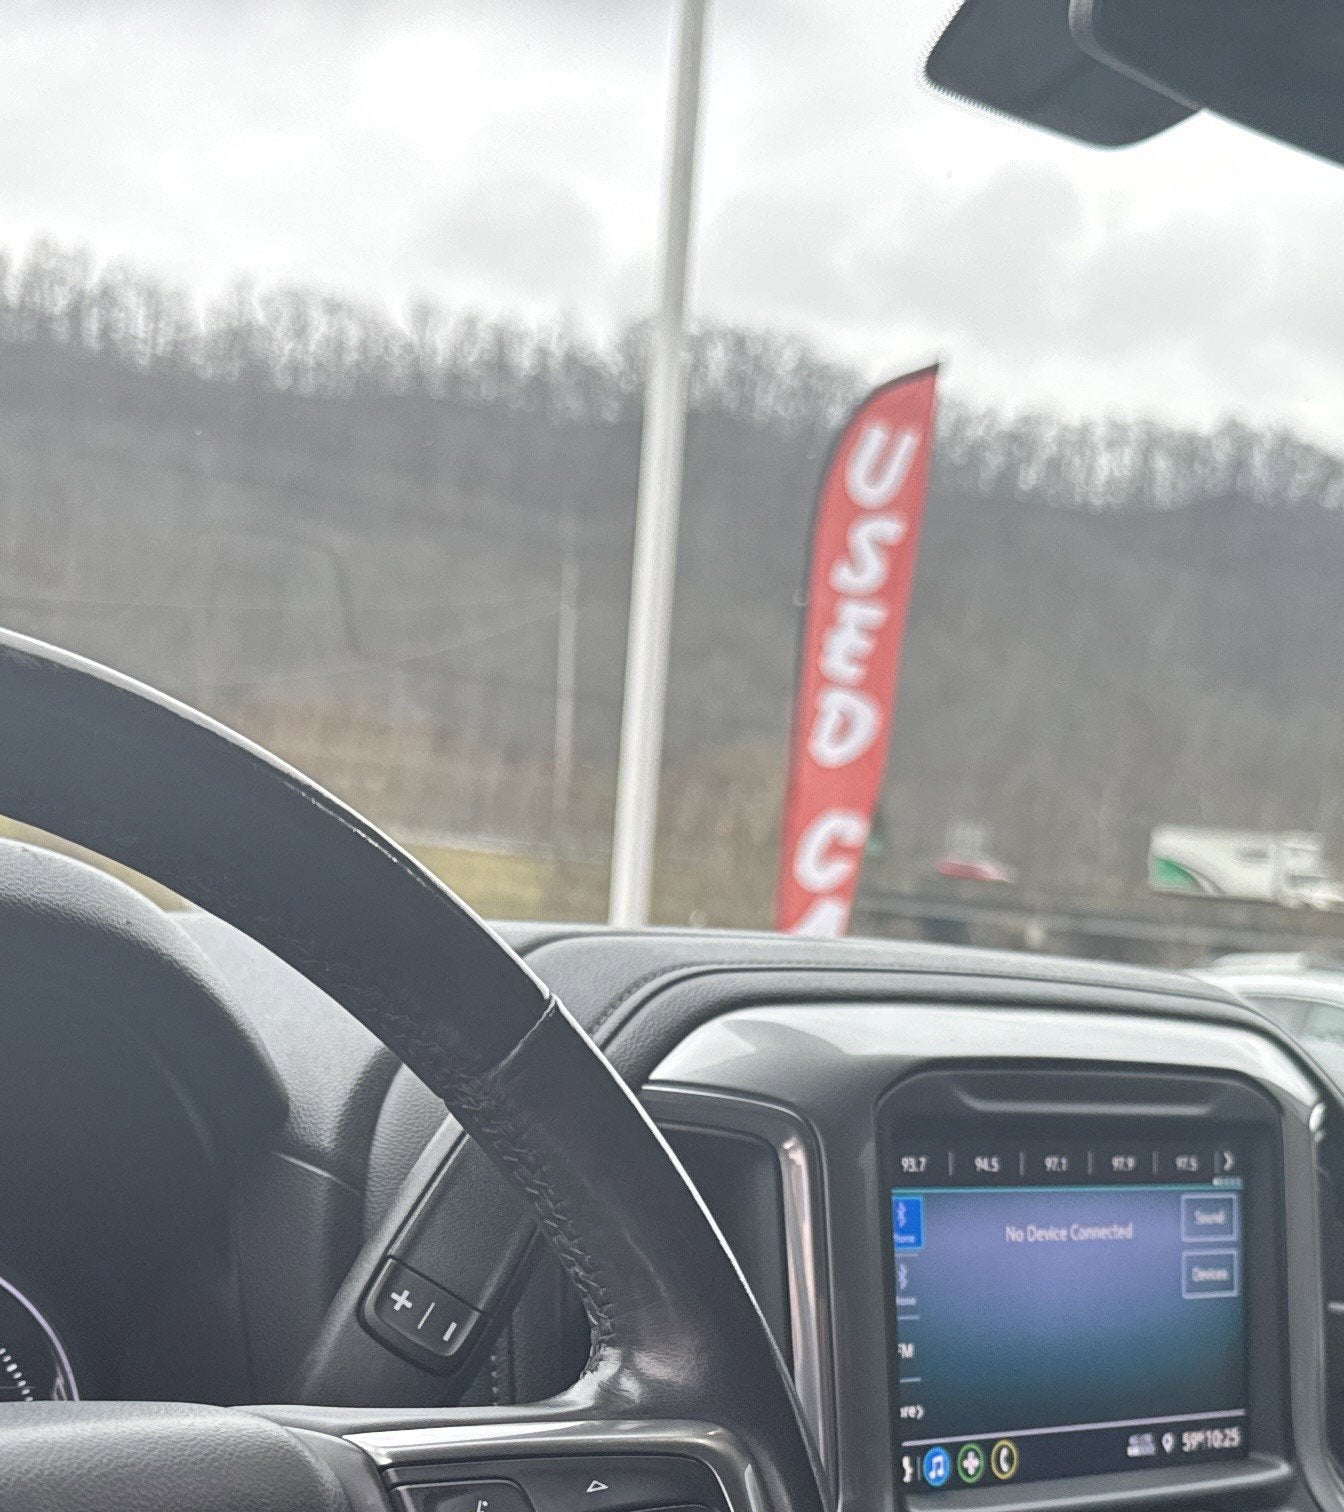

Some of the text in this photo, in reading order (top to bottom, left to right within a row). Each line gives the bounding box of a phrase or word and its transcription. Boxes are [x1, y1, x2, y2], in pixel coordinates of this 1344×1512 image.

[808, 424, 920, 768] USED
[1006, 1222, 1134, 1243] No Device Connected
